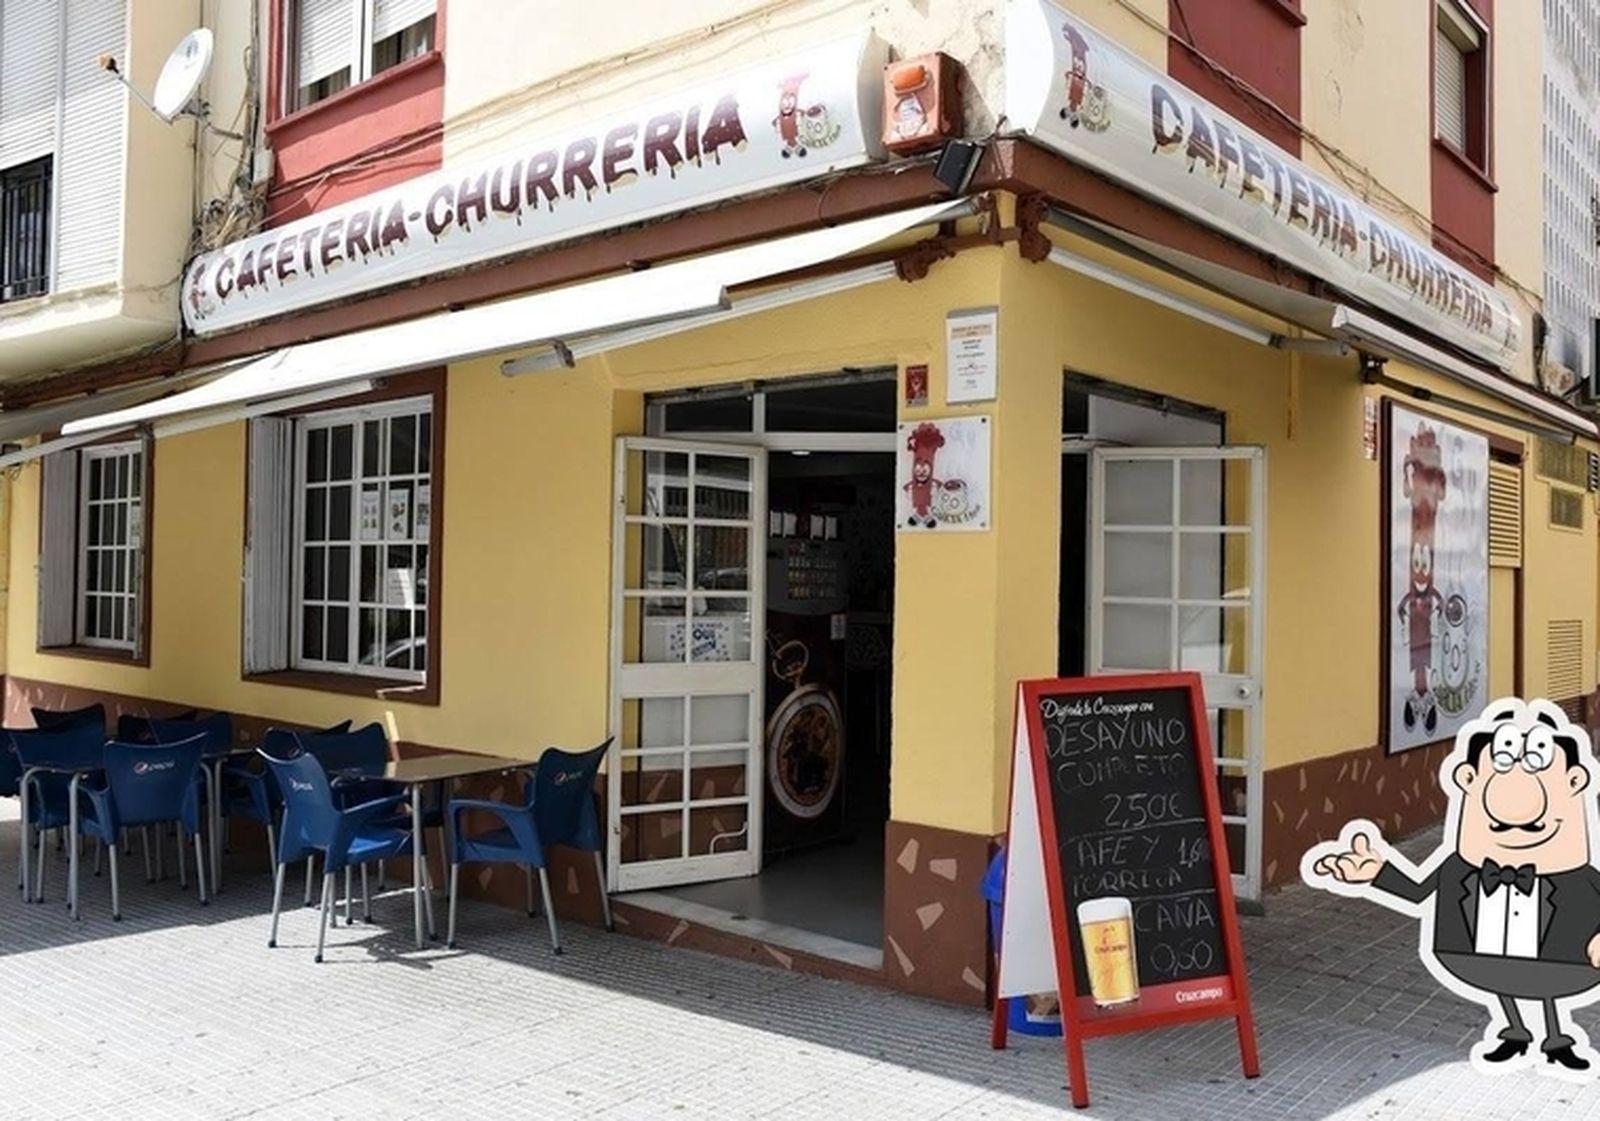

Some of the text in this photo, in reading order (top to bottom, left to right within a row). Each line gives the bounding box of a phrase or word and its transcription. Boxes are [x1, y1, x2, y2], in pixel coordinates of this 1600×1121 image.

[214, 93, 750, 302] CAFETERIA-CHURRERIA
[1151, 84, 1495, 334] CAFETERIA-CHURRERIA
[1045, 718, 1186, 758] DESAYUNO
[1103, 793, 1184, 829] 2,50€
[1142, 834, 1160, 862] Y
[1135, 897, 1216, 933] CAÑA
[1175, 986, 1223, 1004] Cruzcampo
